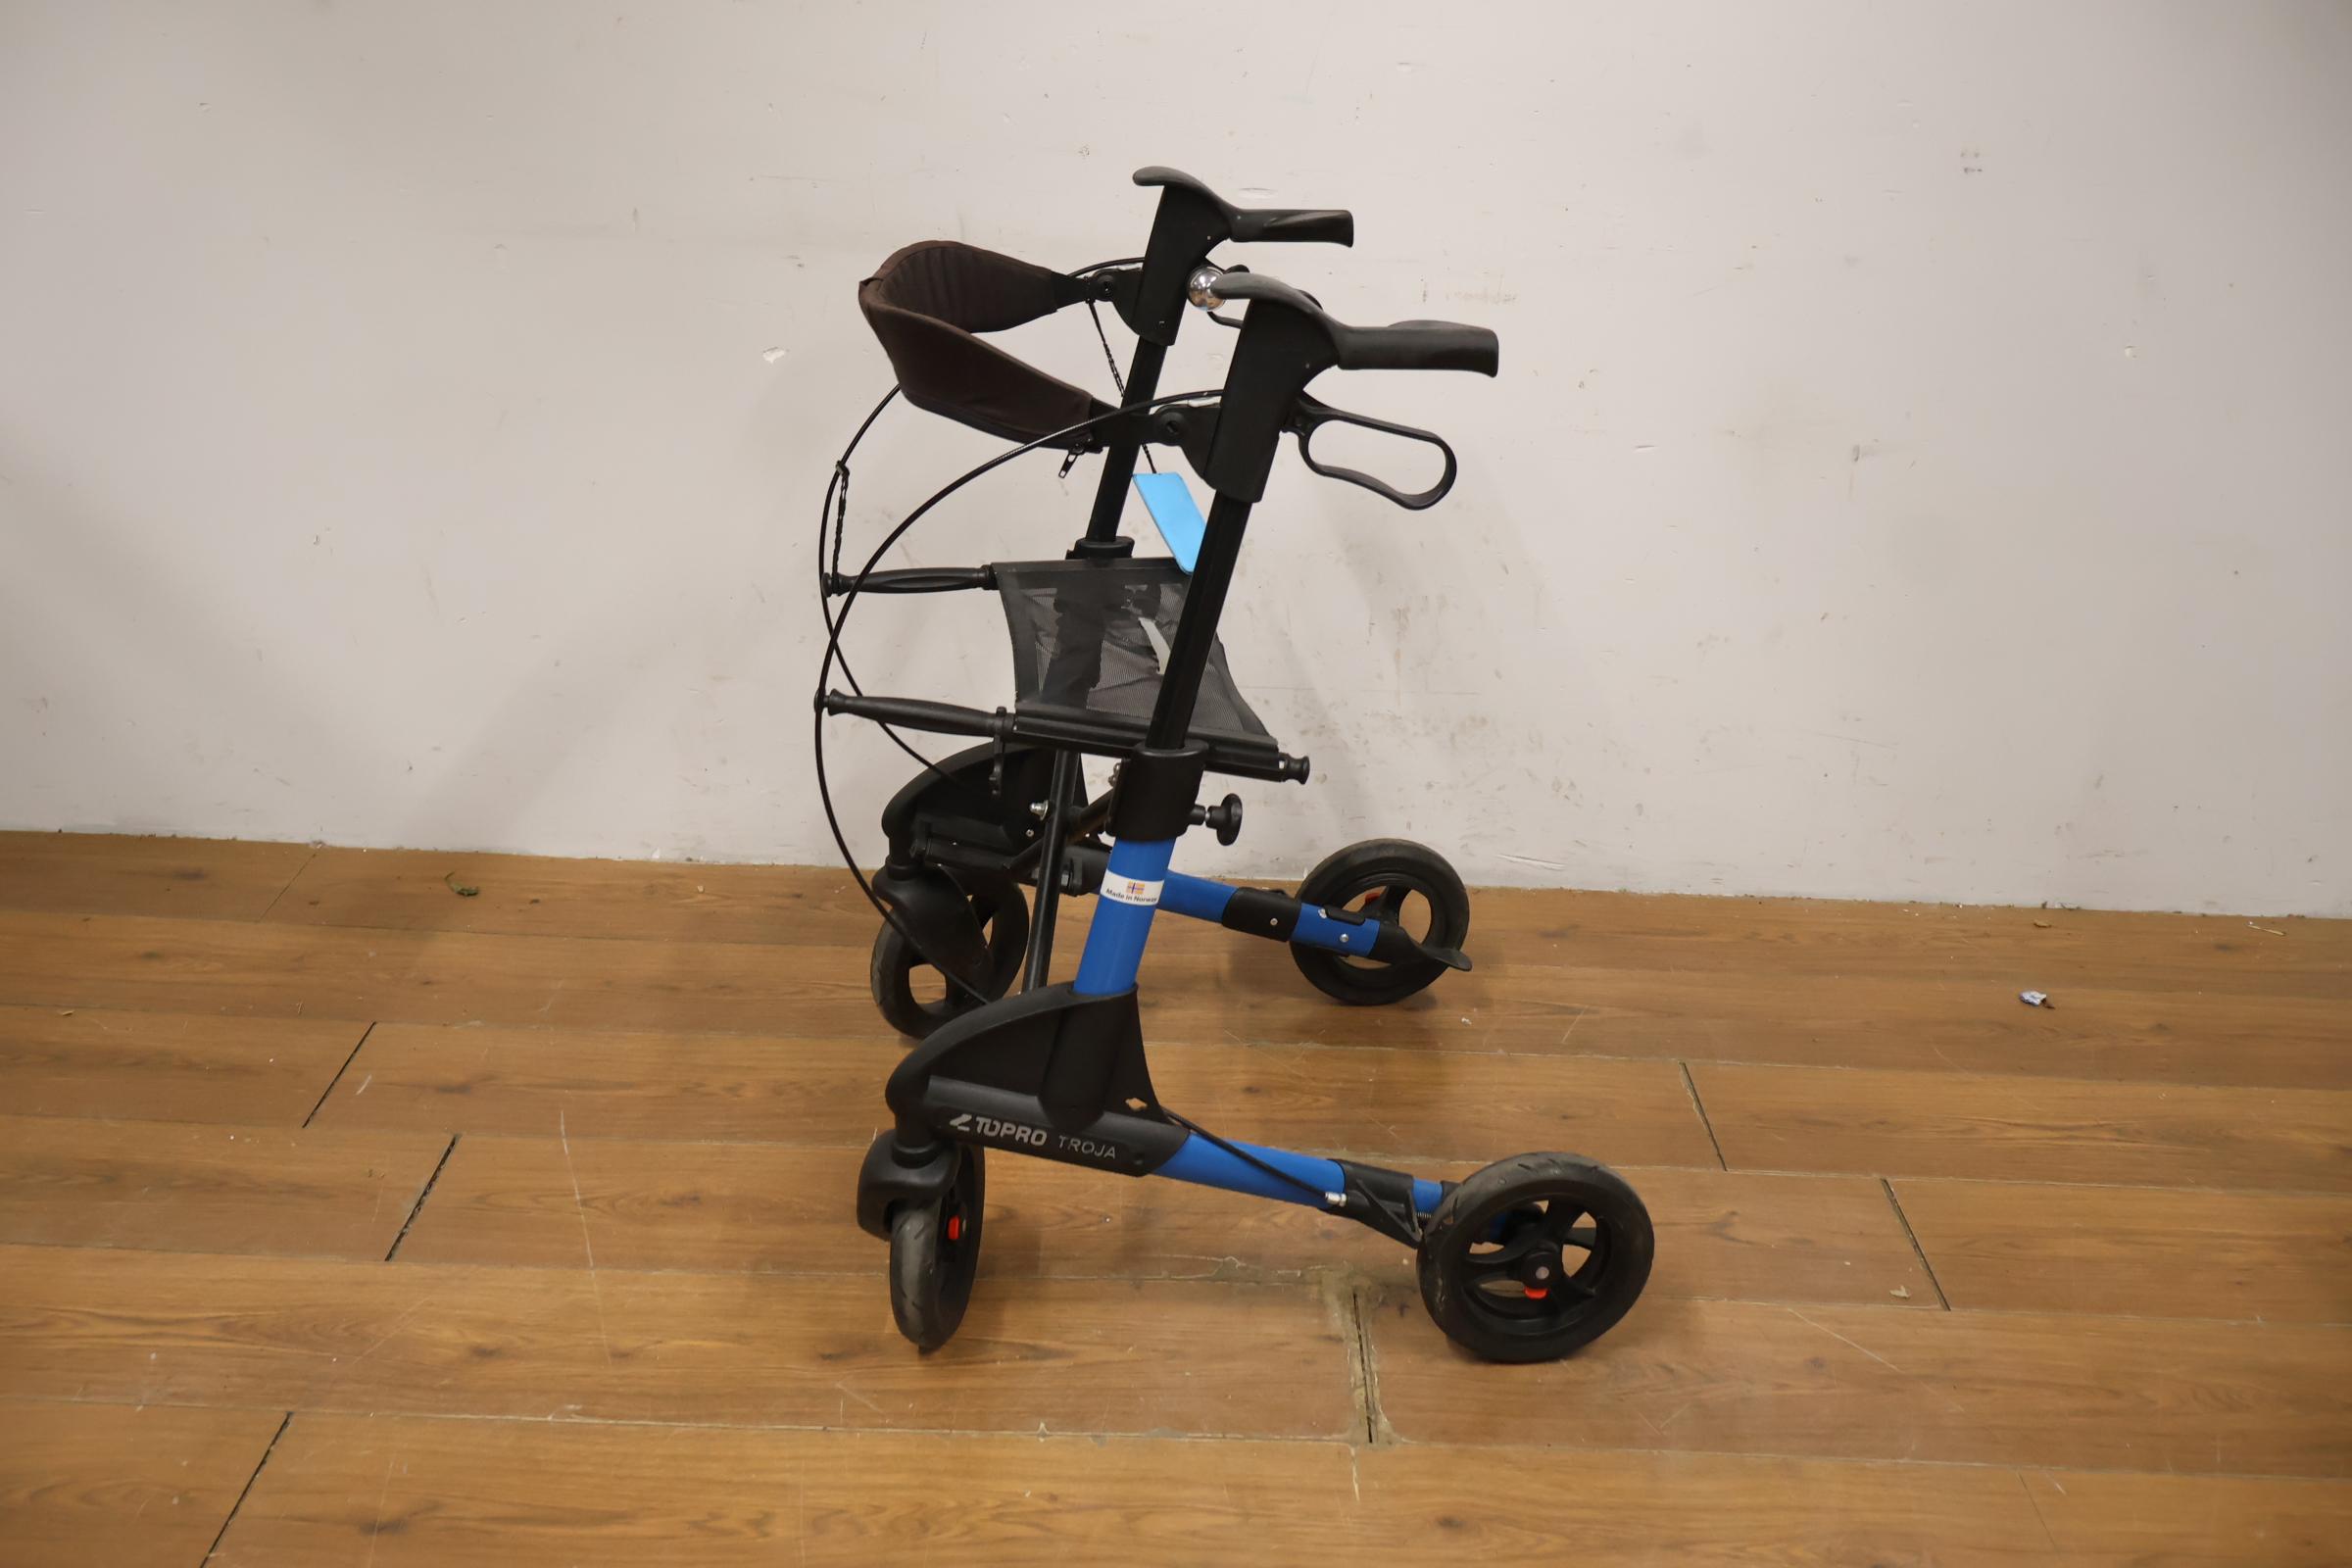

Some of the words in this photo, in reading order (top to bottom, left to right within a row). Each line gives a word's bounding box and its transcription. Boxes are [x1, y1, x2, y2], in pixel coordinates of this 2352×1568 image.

[1105, 888, 1125, 900] Made
[975, 1116, 1048, 1147] TOPRO
[1057, 1135, 1117, 1159] TROJA
